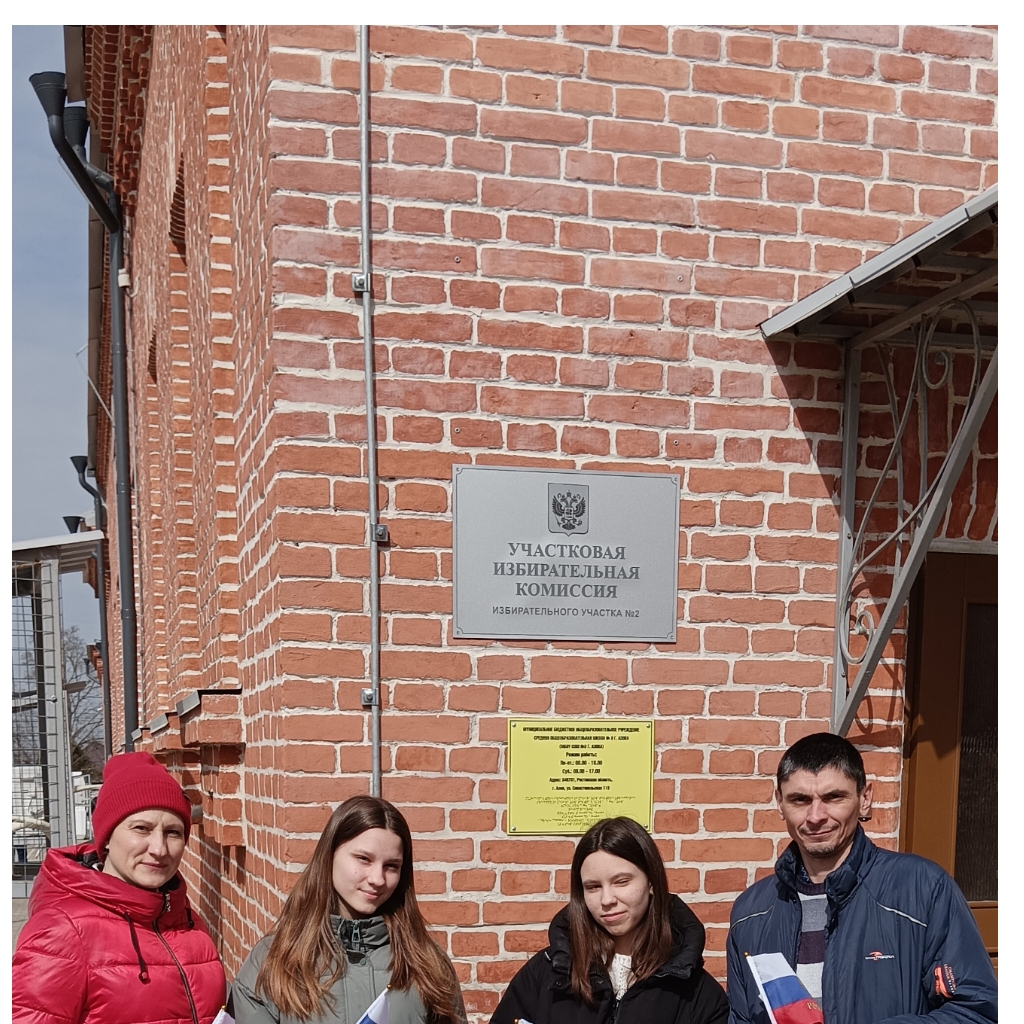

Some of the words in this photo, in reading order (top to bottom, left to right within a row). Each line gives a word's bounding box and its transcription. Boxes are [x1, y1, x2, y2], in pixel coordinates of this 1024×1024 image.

[508, 542, 626, 560] УЧАСТКОВАЯ
[492, 561, 640, 580] ИЗБИРАТЕЛЬНАЯ
[515, 582, 618, 599] КОМИССИЯ
[492, 606, 579, 617] ИЗБИРАТЕЛЬНОГО
[581, 608, 623, 618] УЧАСТКА
[625, 609, 640, 618] №2
